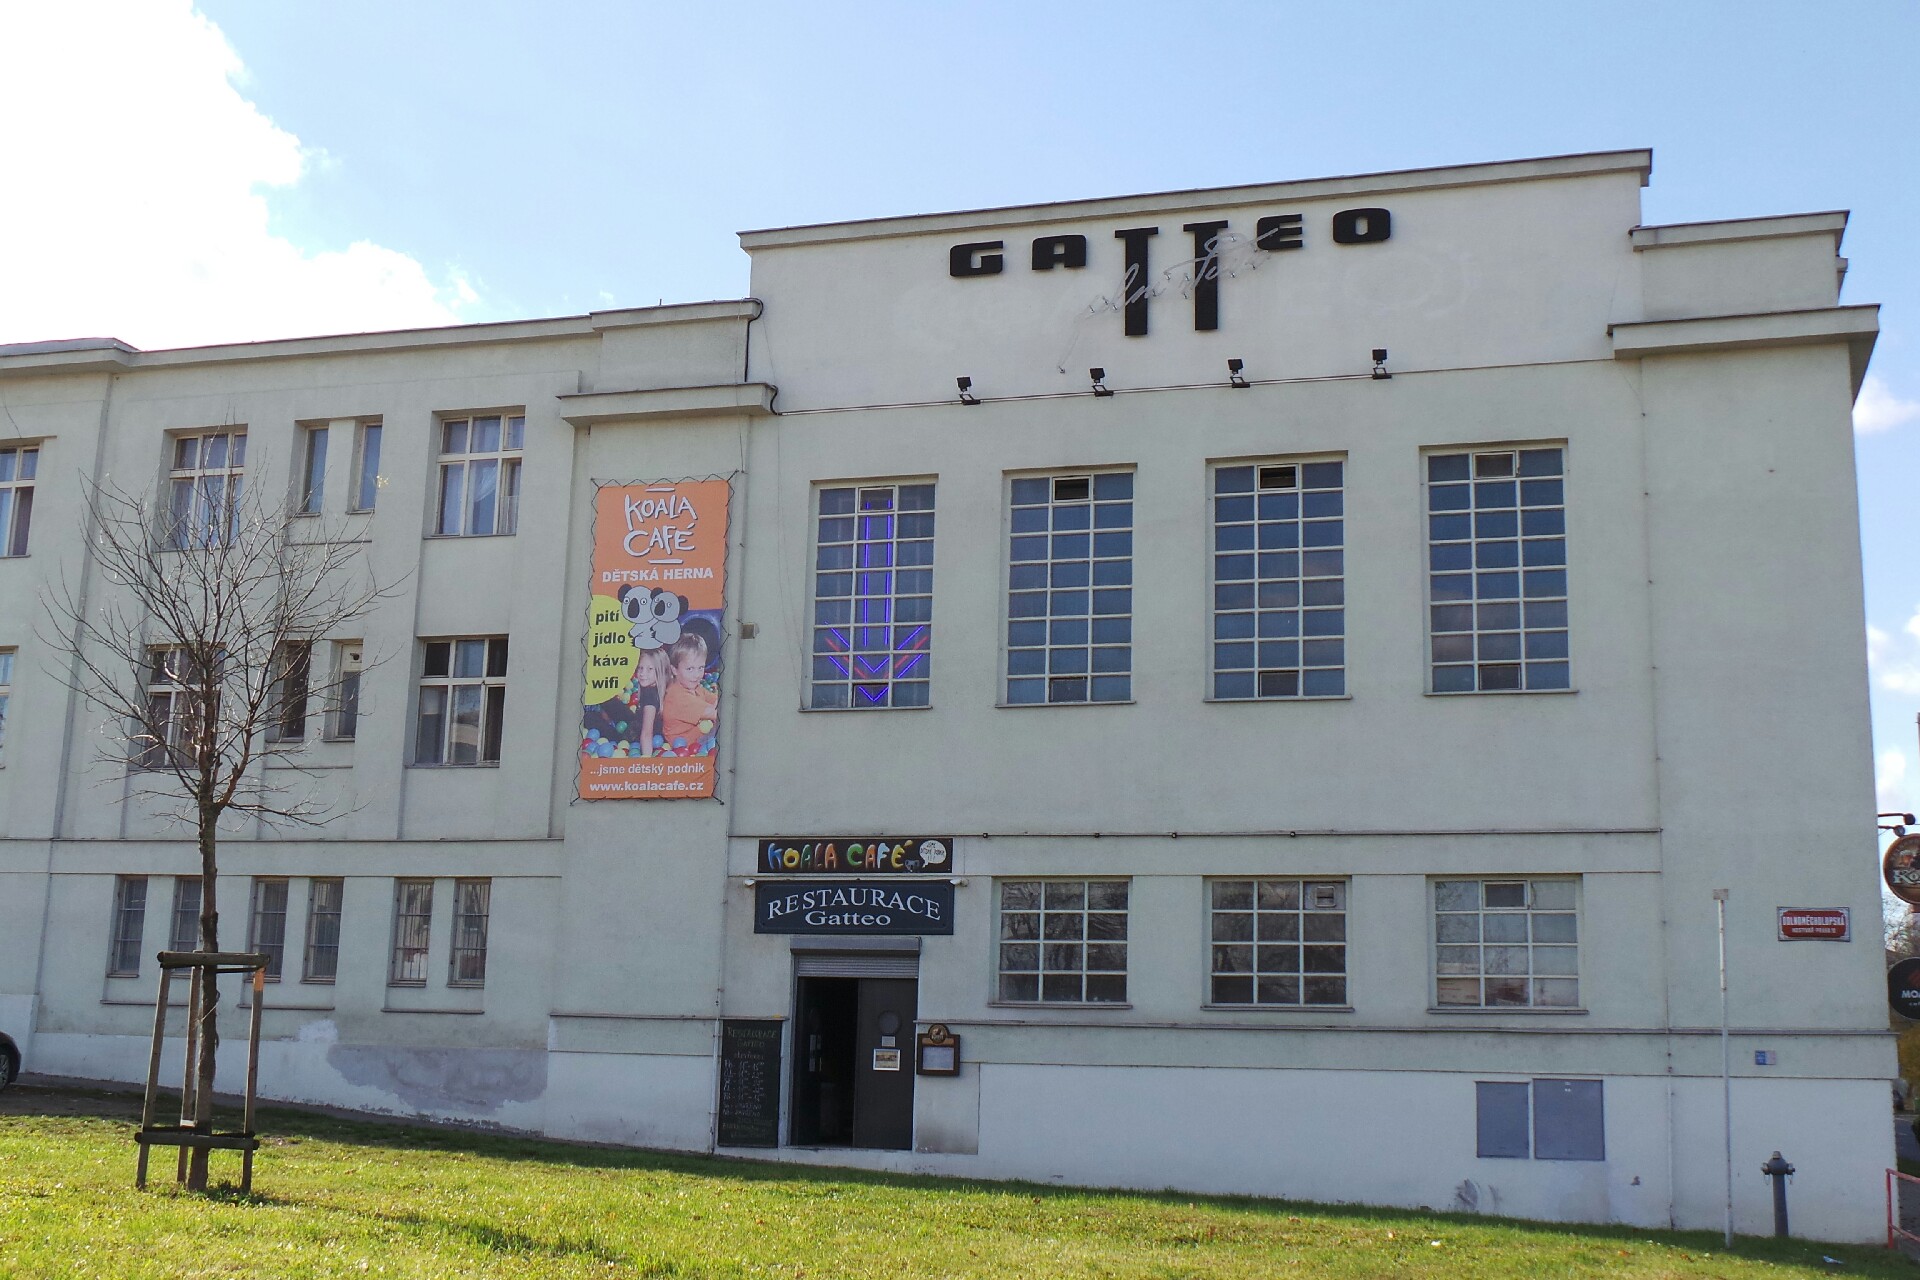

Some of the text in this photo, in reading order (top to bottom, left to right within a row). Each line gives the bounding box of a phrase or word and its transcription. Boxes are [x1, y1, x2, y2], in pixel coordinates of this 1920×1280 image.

[950, 208, 1391, 337] GATTEO
[624, 494, 698, 531] KOALA
[623, 522, 695, 558] CAFÉ
[602, 567, 714, 583] DĚTSKÁ HERNA
[595, 610, 620, 626] pití
[593, 632, 626, 648] jídlo
[593, 653, 629, 667] káva
[592, 675, 619, 690] wifi
[627, 762, 664, 777] dětský
[667, 761, 705, 776] podnik
[589, 780, 704, 793] www.koalacafe.cz
[767, 839, 913, 870] KOALA CAFÉ
[1893, 869, 1920, 884] Ko
[767, 887, 941, 921] RESTAURACE
[805, 910, 891, 926] Gatteo
